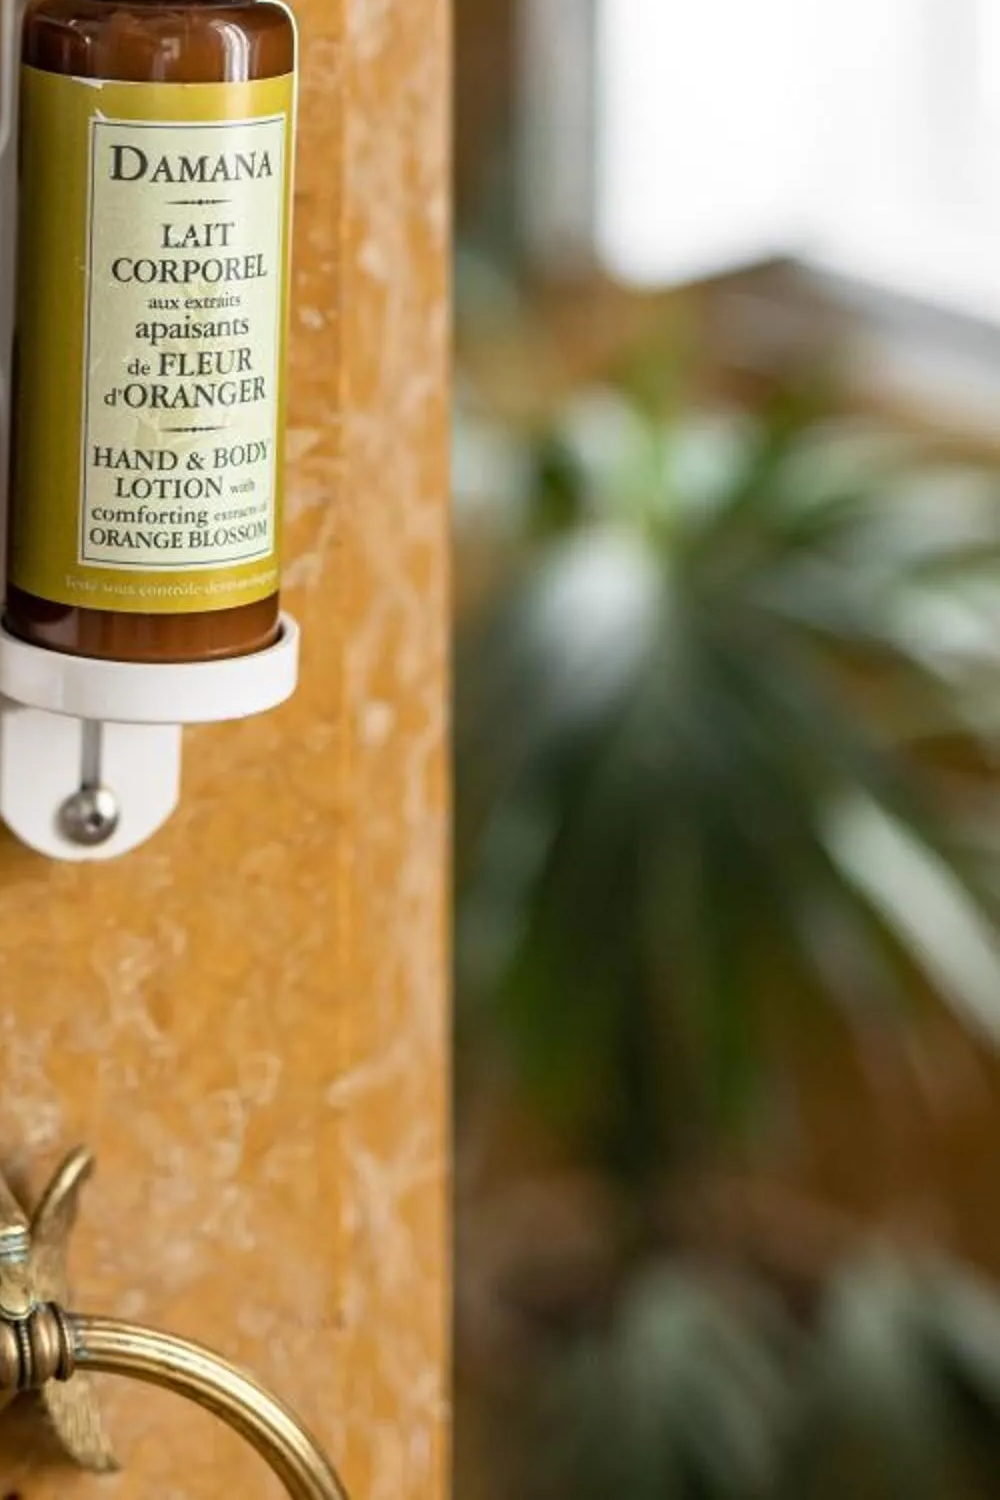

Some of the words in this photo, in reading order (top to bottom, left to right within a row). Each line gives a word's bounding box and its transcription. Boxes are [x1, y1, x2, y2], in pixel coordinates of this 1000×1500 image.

[161, 221, 235, 249] LAIT
[111, 253, 268, 284] CORPOREL
[148, 297, 179, 310] aux
[184, 291, 241, 310] extraits
[135, 315, 249, 346] apaisants
[127, 358, 151, 377] de
[158, 347, 253, 378] FLEUR
[104, 376, 266, 410] d'ORANGER
[92, 445, 178, 472] HAND
[186, 452, 206, 471] &
[213, 440, 270, 470] BODY
[114, 476, 223, 499] LOTION
[229, 477, 255, 494] with
[91, 504, 209, 529] comforting
[89, 527, 184, 550] ORANGE
[189, 519, 267, 549] BLOSSOM
